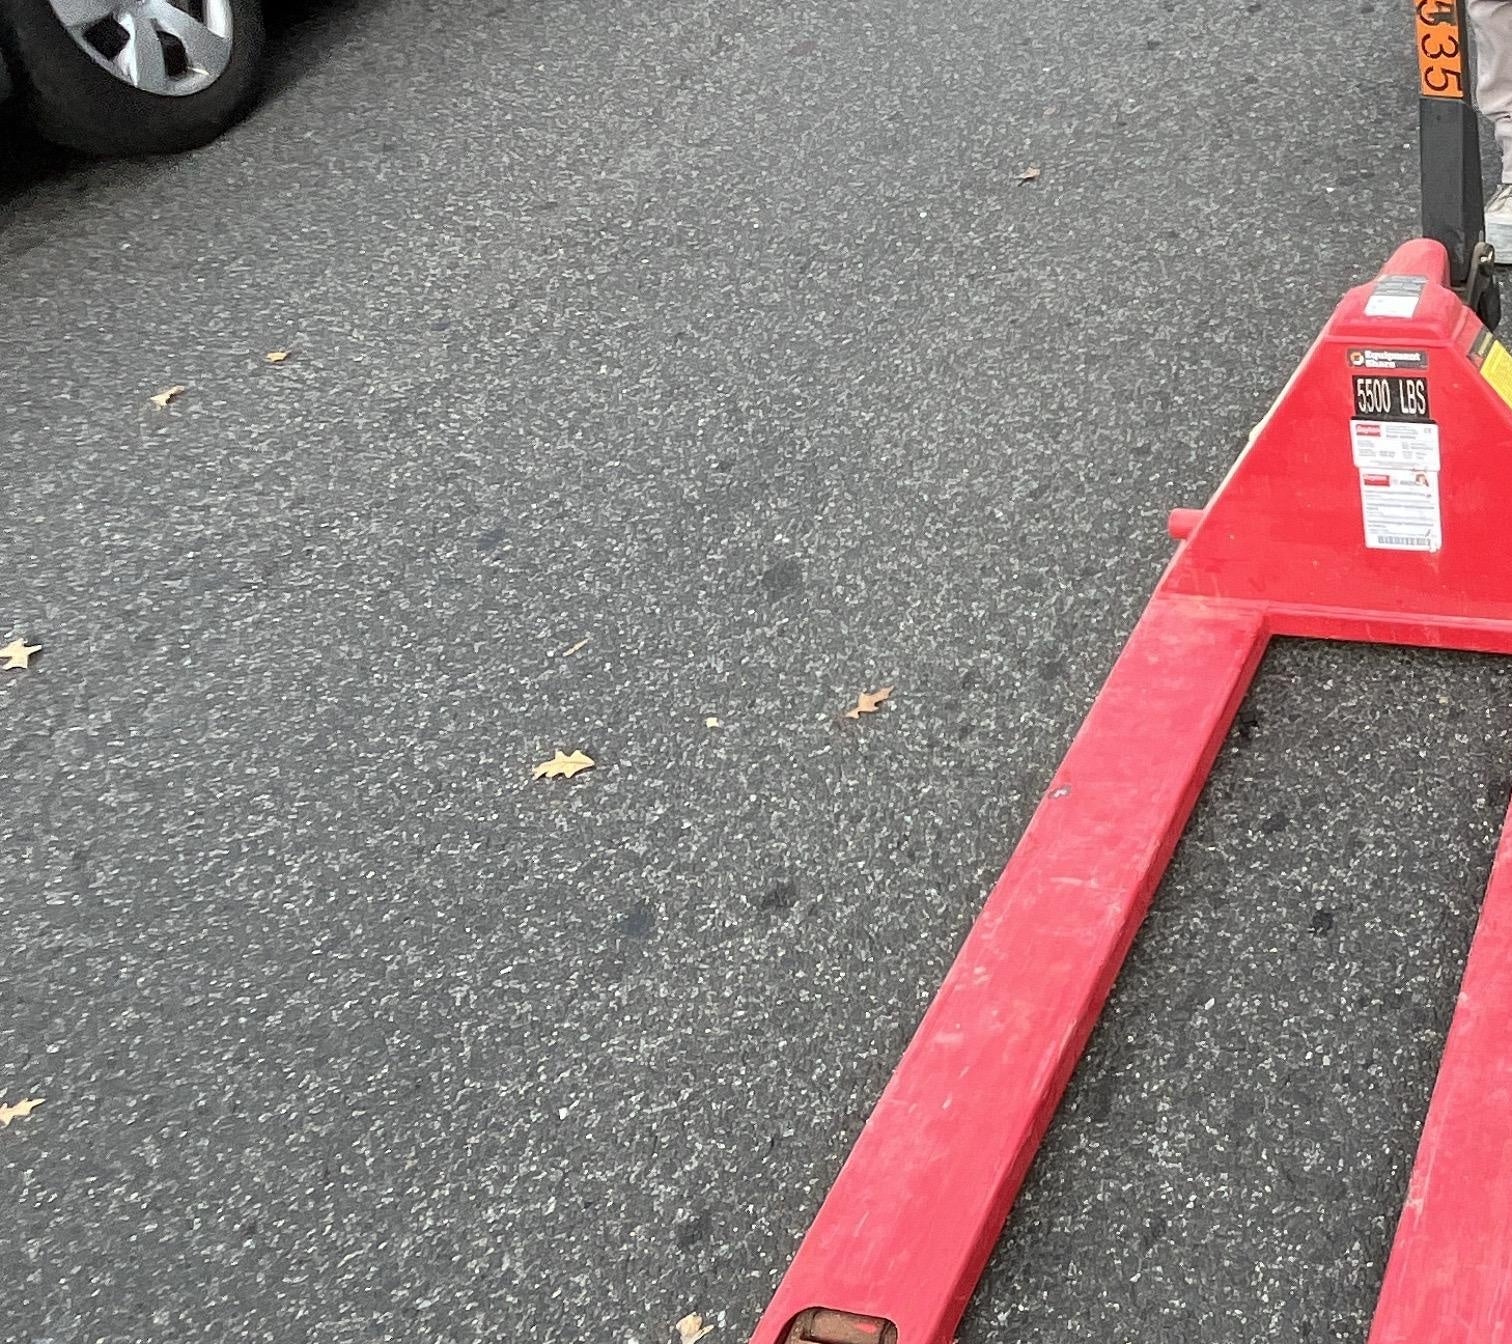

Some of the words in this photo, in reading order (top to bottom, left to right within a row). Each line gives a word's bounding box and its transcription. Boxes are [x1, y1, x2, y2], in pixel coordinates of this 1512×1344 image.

[1364, 350, 1421, 361] Equipment
[1357, 378, 1391, 413] 5500
[1399, 379, 1426, 414] LBS
